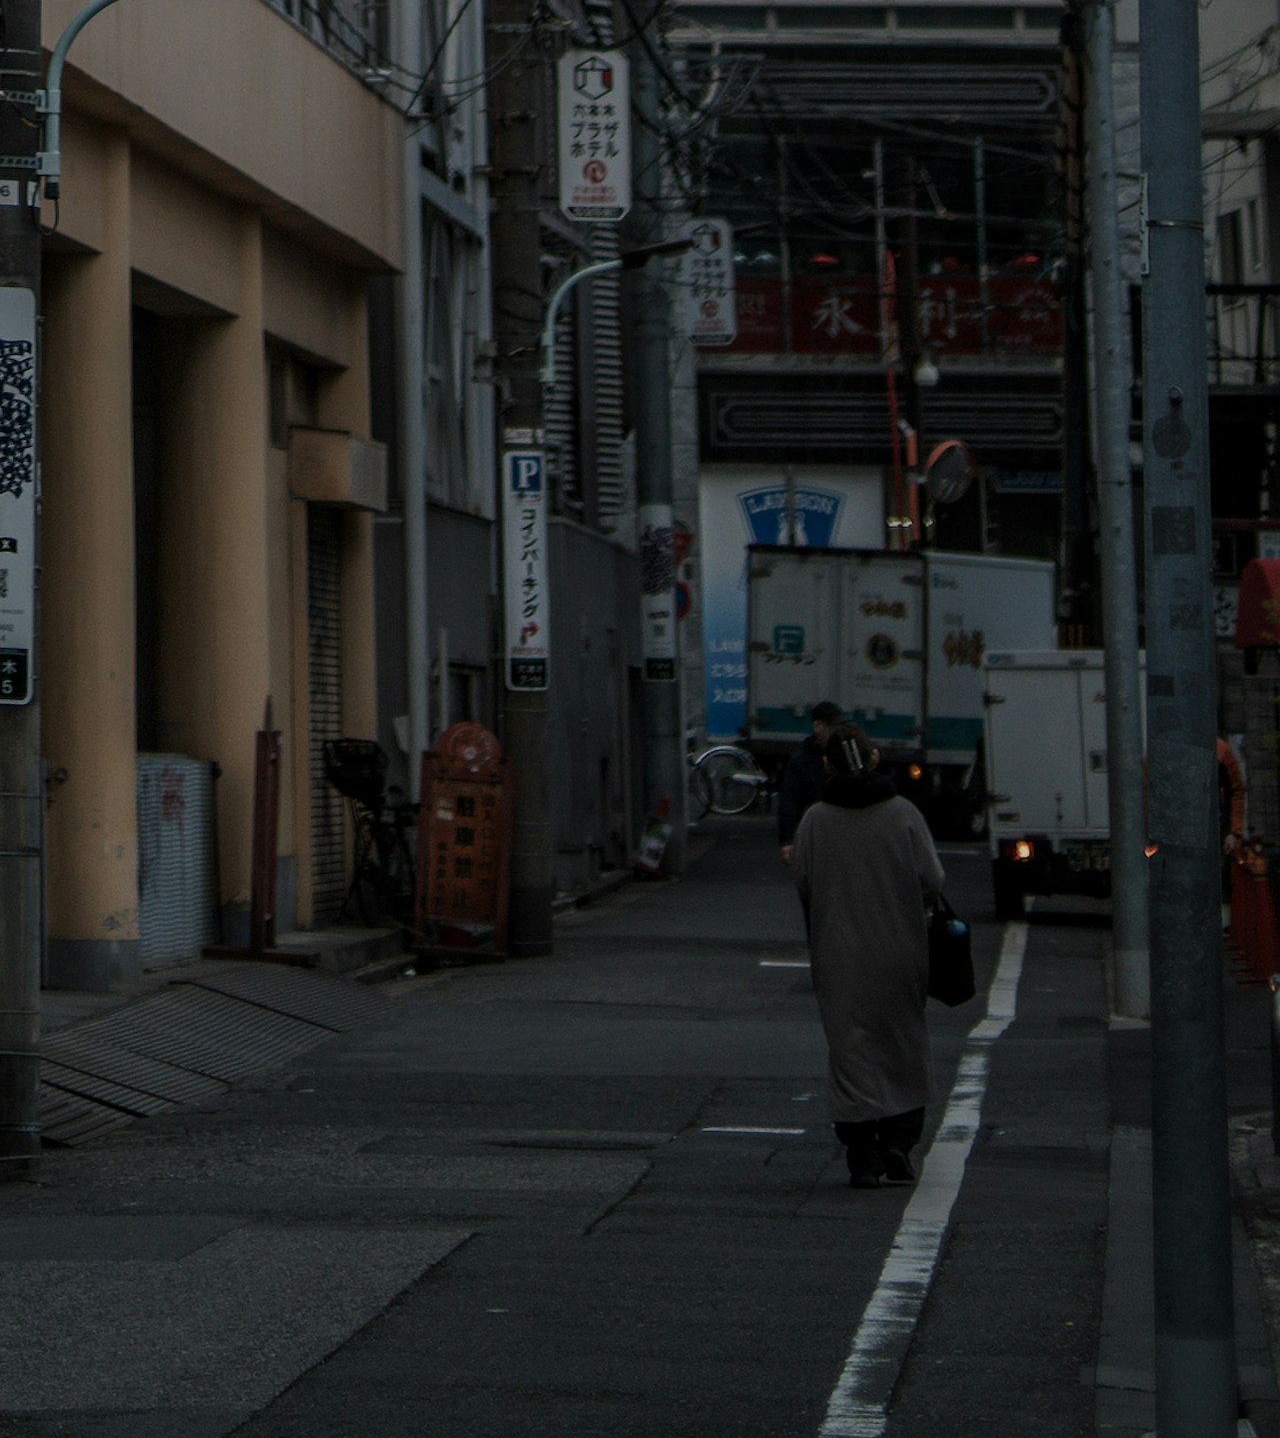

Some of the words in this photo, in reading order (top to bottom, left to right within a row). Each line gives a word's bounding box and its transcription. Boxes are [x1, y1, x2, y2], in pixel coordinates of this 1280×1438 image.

[570, 141, 619, 158] ホテル
[516, 459, 539, 489] P
[521, 509, 539, 618] コインパーキング
